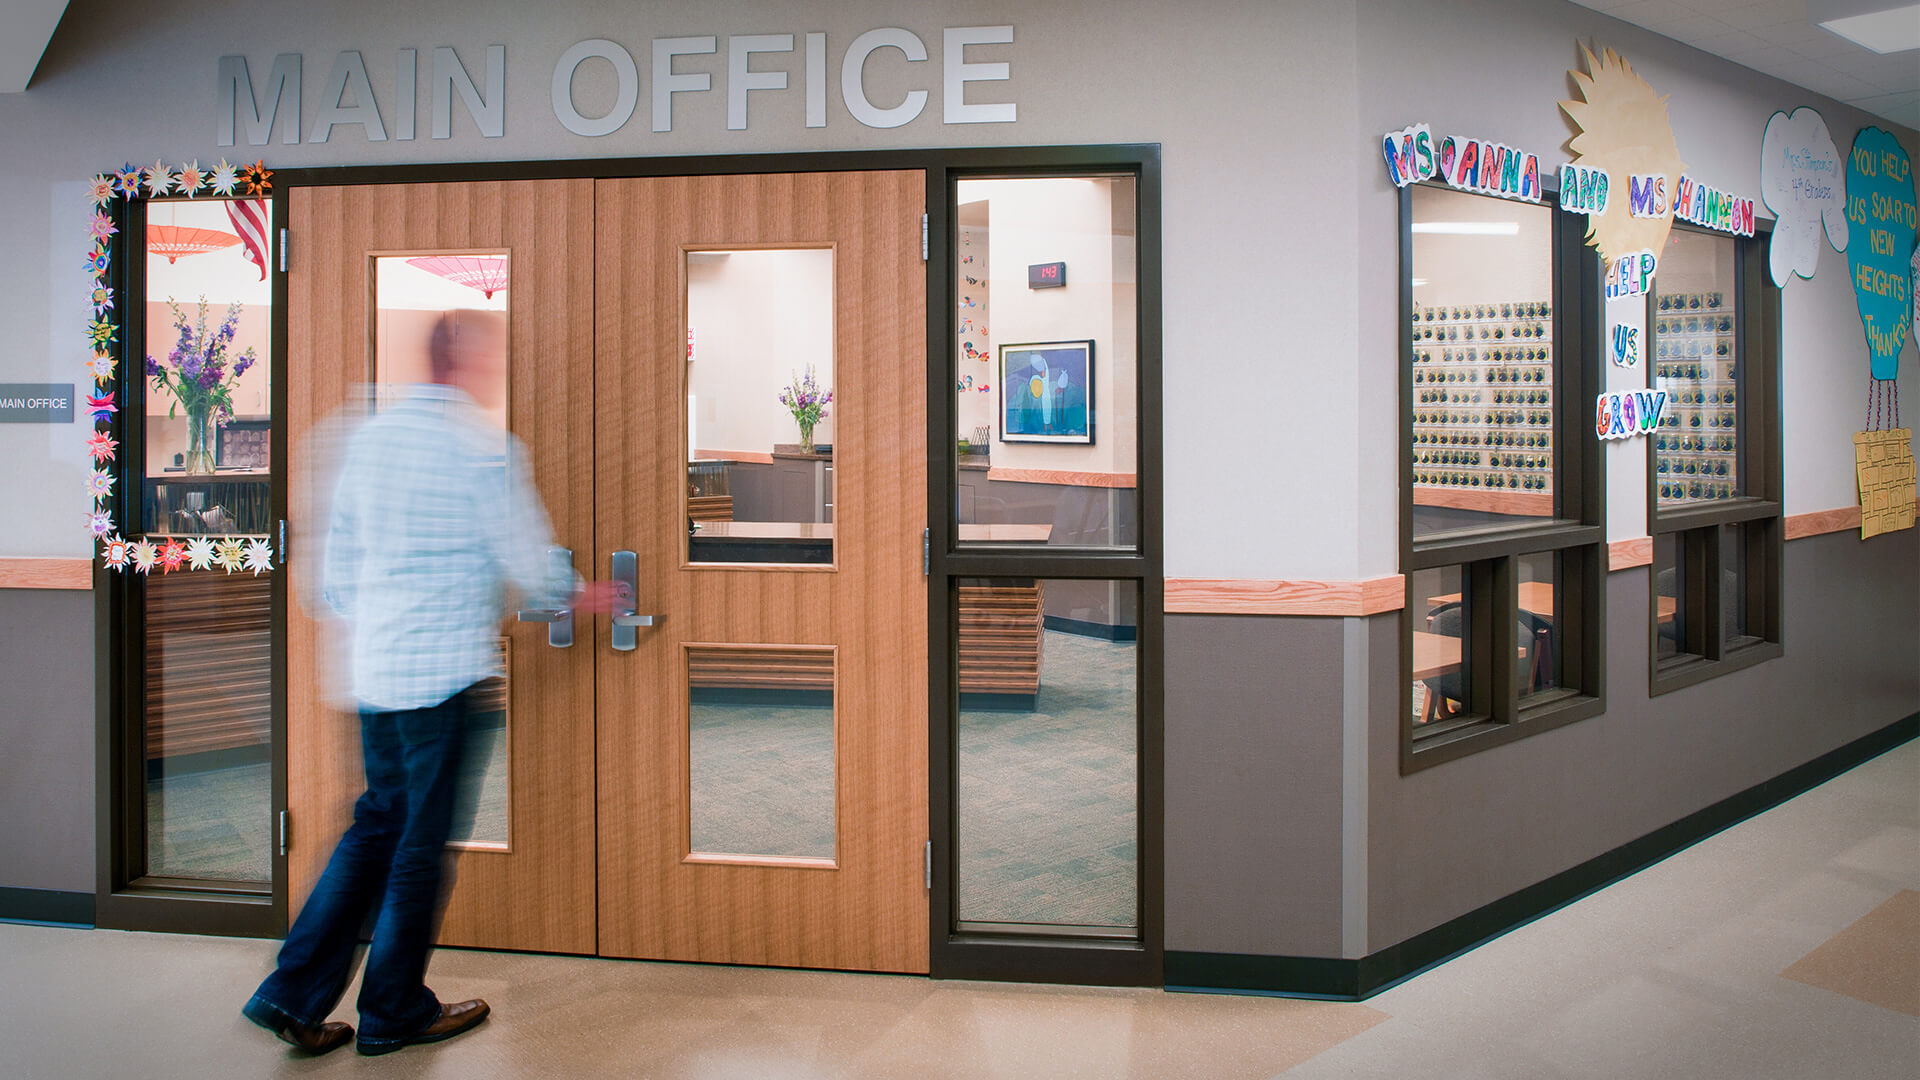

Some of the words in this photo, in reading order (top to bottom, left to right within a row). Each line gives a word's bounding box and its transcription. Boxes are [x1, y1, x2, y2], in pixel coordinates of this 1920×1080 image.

[217, 44, 506, 147] MAIN
[550, 25, 1018, 137] OFFICE
[1384, 130, 1434, 185] MS
[1560, 165, 1609, 213] AND
[1630, 175, 1667, 215] MS
[1672, 174, 1754, 234] SHANNON
[1853, 146, 1877, 177] YOU
[1881, 150, 1909, 183] HELP
[1849, 194, 1866, 225] US
[1872, 192, 1903, 223] SOAR
[1904, 203, 1917, 230] TO
[1870, 228, 1896, 257] NEW
[1606, 253, 1656, 298] HELP
[1613, 323, 1639, 366] US
[0, 398, 25, 409] MAIN
[27, 398, 67, 409] OFFICE
[1597, 391, 1666, 437] GROW
